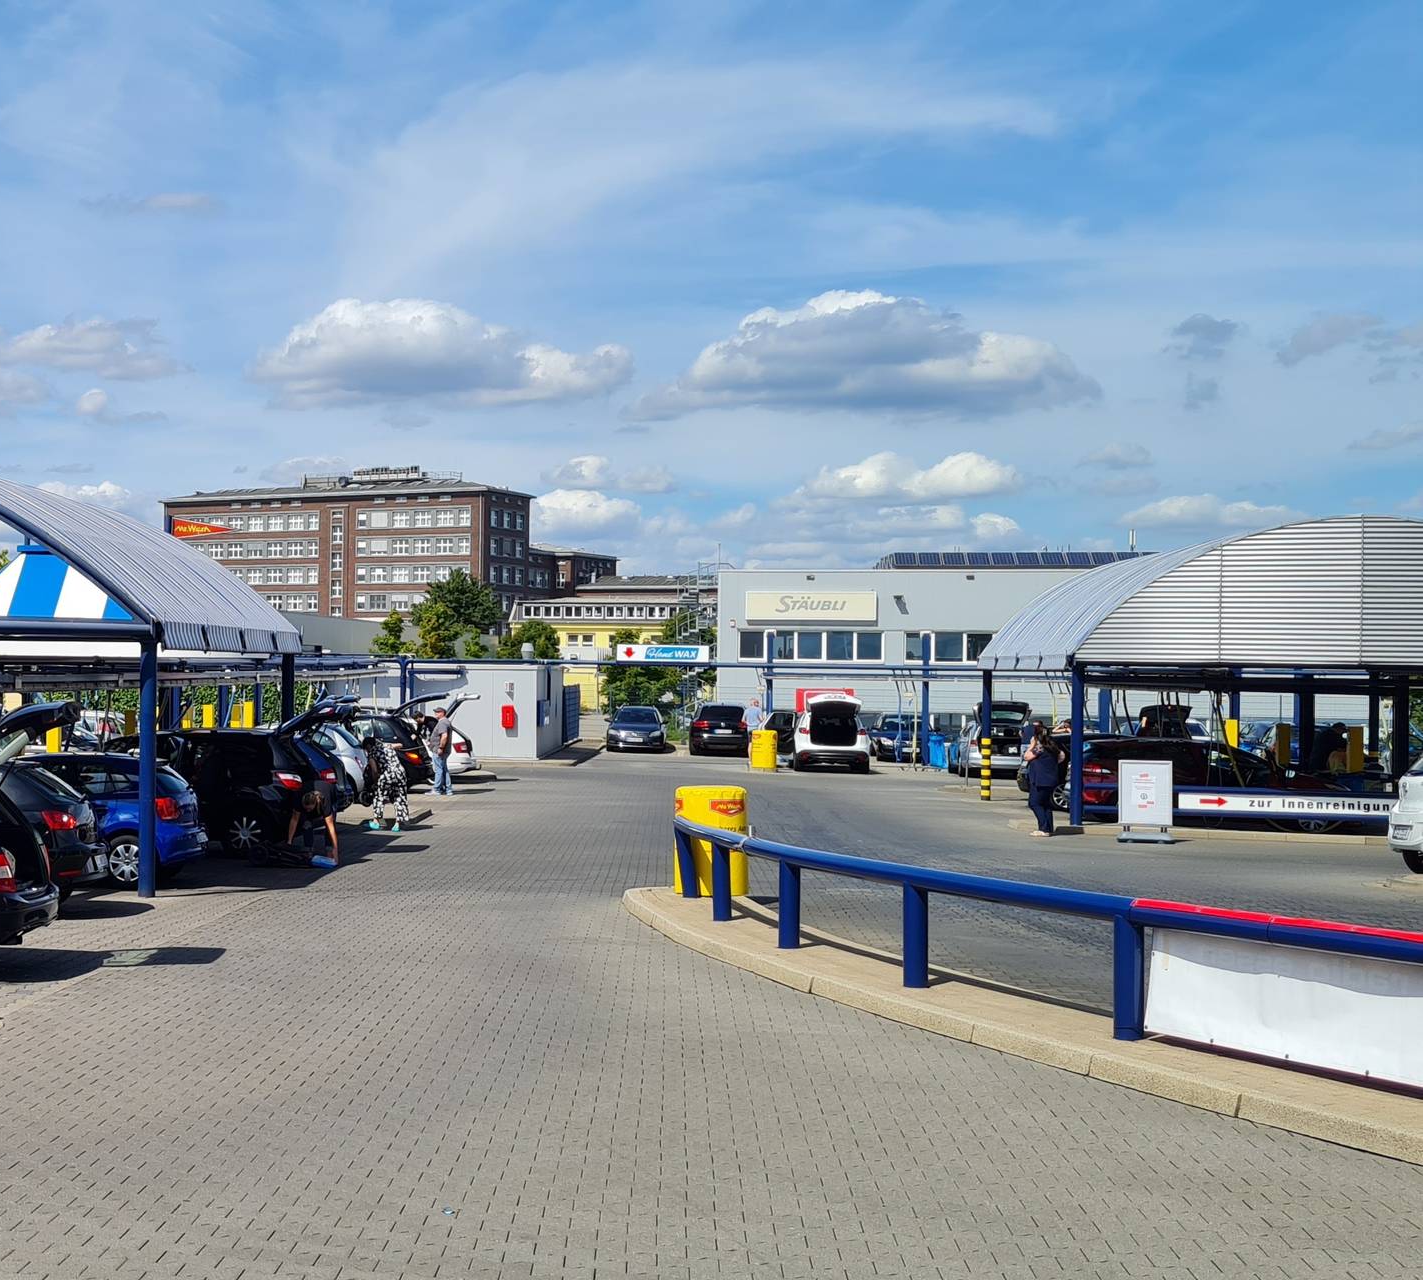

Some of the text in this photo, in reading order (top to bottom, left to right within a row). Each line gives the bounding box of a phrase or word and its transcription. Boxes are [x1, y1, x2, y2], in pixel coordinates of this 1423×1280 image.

[775, 595, 847, 613] STÄUBLI
[674, 650, 697, 659] WAX
[1248, 799, 1393, 813] zur Innenreinigun
